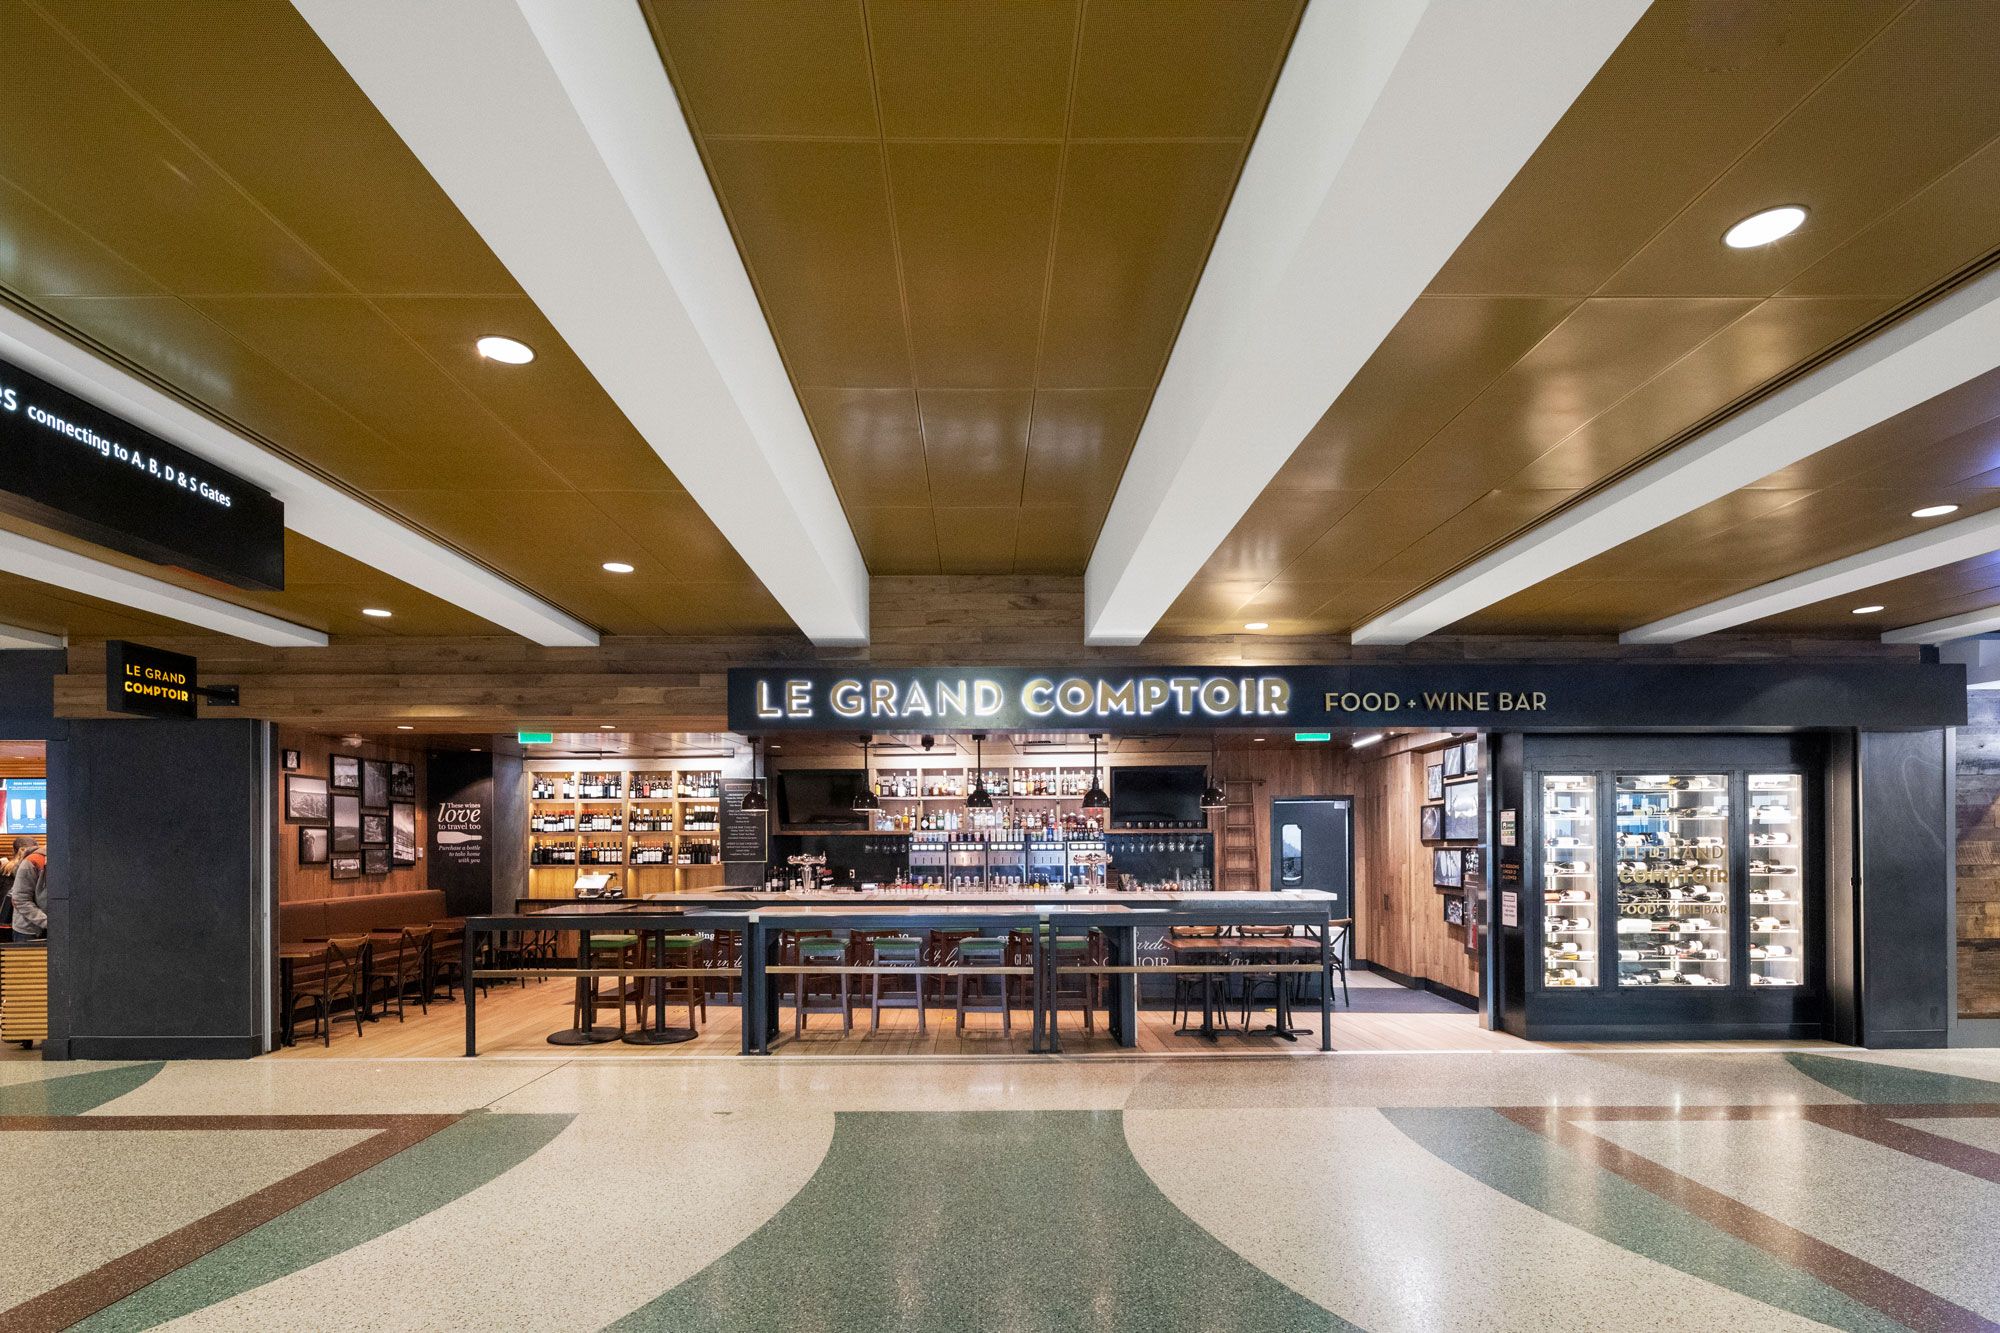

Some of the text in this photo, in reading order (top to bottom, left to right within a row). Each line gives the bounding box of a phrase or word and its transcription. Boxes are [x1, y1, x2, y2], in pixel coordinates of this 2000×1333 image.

[27, 405, 110, 457] connecting
[113, 443, 128, 460] to
[131, 451, 145, 470] A,
[149, 458, 161, 478] B,
[165, 465, 175, 481] D
[177, 472, 187, 488] &
[189, 477, 198, 492] S
[200, 482, 231, 507] Gates
[126, 664, 186, 685] LE GRAND
[124, 681, 189, 702] COMPTOIR
[756, 678, 1291, 718] LE GRAND COMPTOIR
[1325, 692, 1400, 712] FOOD
[1424, 692, 1490, 712] WINE
[1500, 692, 1547, 712] BAR
[437, 802, 481, 823] love
[447, 822, 468, 830] travel
[1619, 868, 1728, 884] COMPTOIR
[1620, 903, 1657, 915] FOOD
[1667, 904, 1700, 915] WINE
[1702, 904, 1728, 915] BAR
